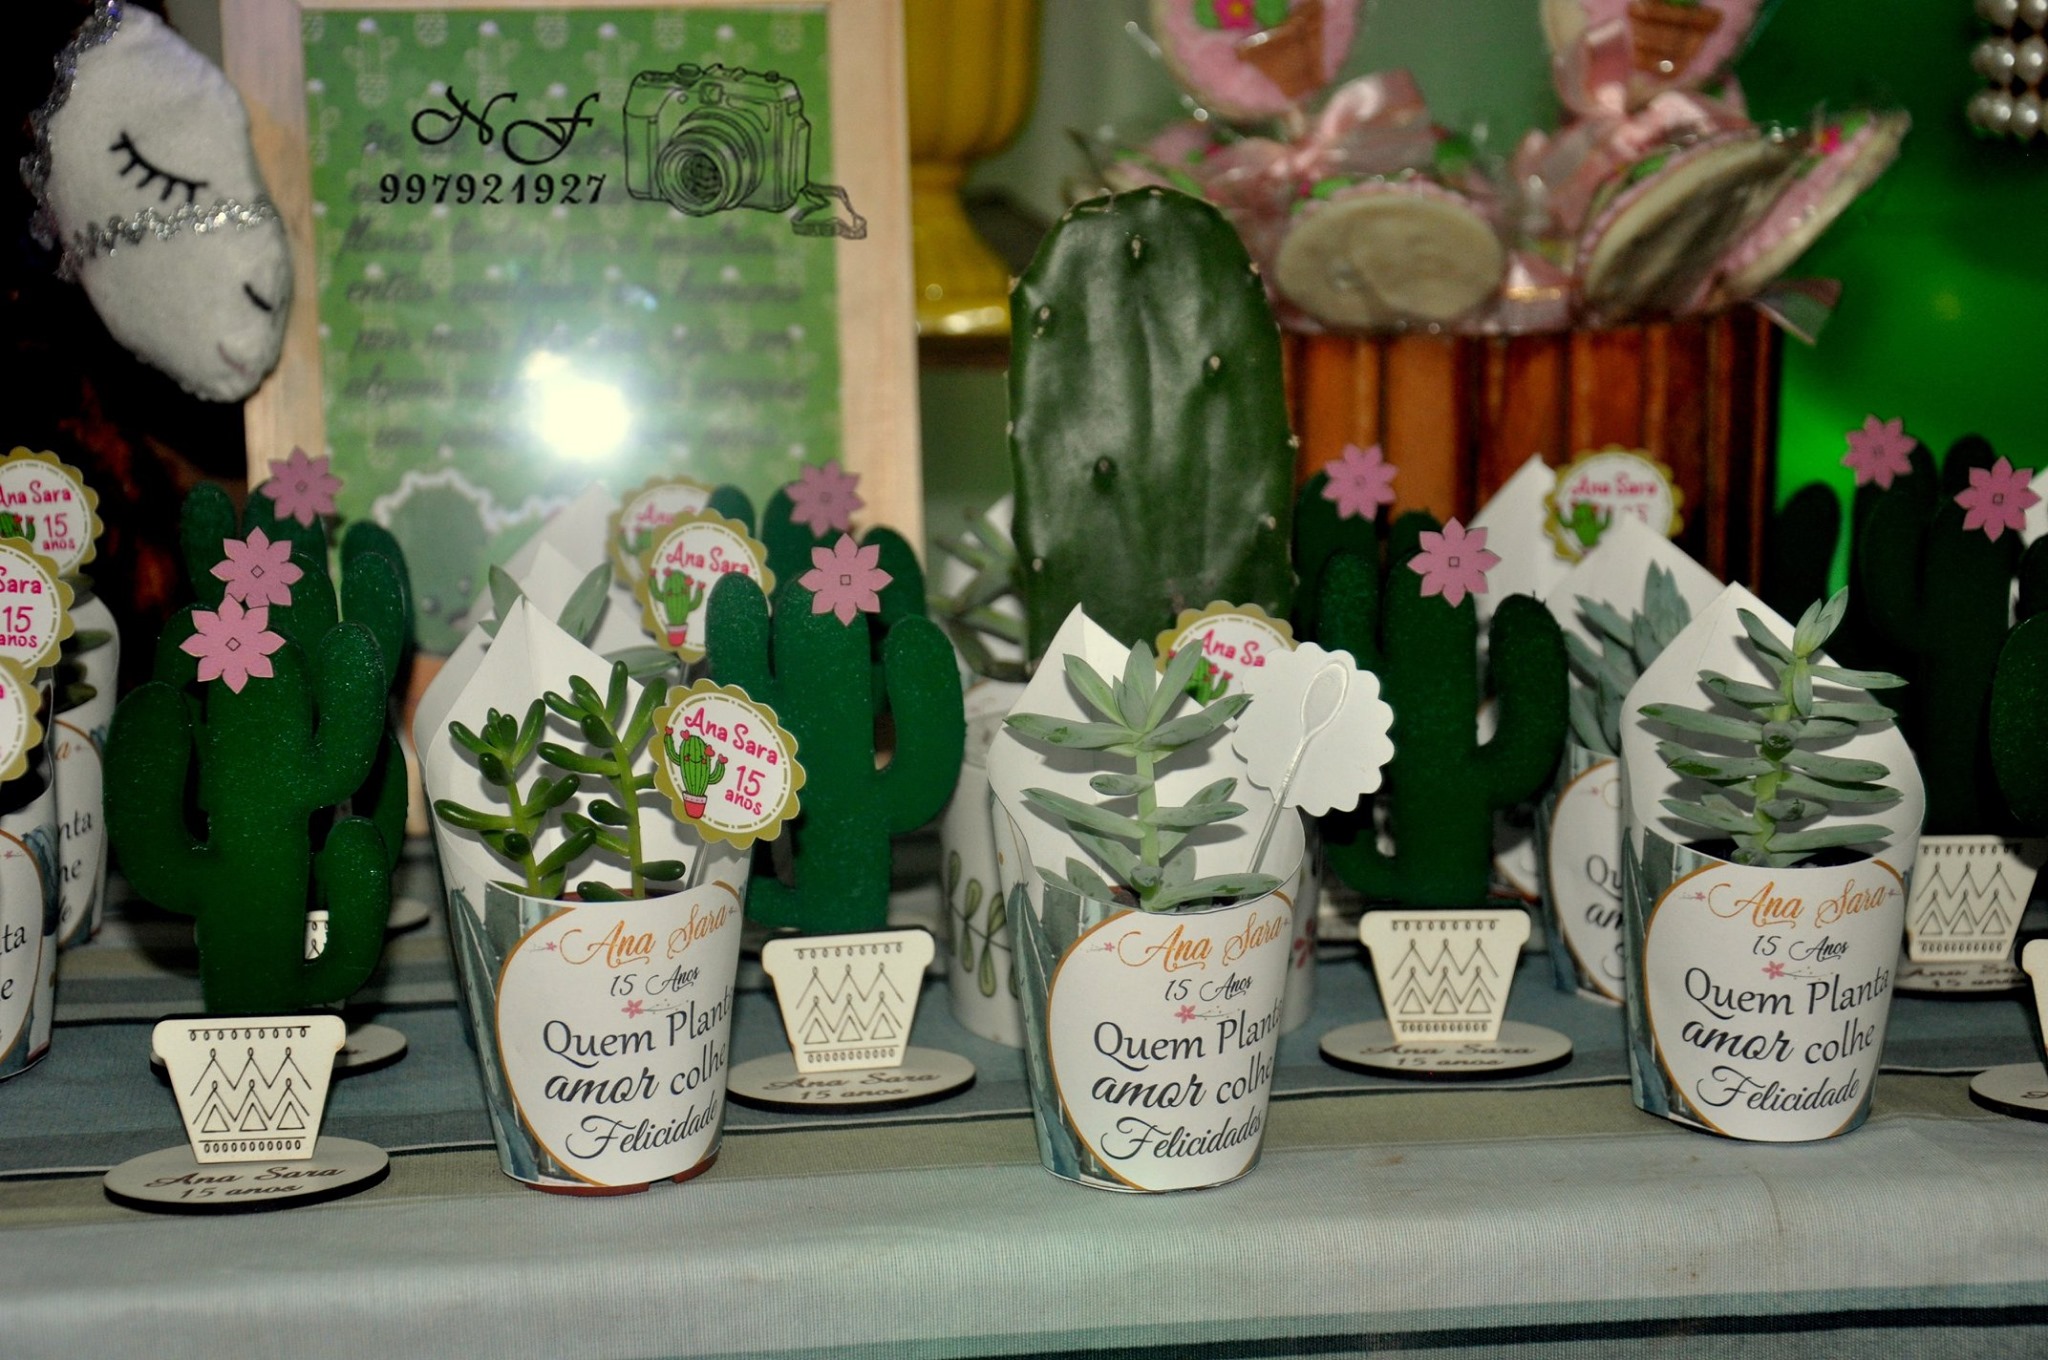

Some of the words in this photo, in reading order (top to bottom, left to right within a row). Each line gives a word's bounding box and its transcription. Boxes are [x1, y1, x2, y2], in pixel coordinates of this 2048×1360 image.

[29, 480, 73, 504] Sara
[43, 512, 68, 538] 15
[42, 537, 76, 551] anos
[666, 541, 705, 569] Ana
[2, 605, 34, 633] 15
[1196, 629, 1237, 660] Ana
[684, 707, 728, 742] Ana
[732, 723, 778, 765] Sara
[736, 765, 766, 797] 15
[724, 788, 763, 816] anos
[1707, 881, 1805, 928] Ana
[1814, 878, 1888, 928] Sara
[558, 919, 656, 969] Ana
[666, 903, 728, 960] Sara
[1117, 923, 1213, 973] Ana
[1221, 912, 1282, 966] Sara
[1752, 935, 1782, 957] 15
[1788, 935, 1849, 962] Anos
[609, 973, 638, 997] 15
[645, 964, 700, 996] Anos
[1164, 978, 1193, 1001] 15
[1199, 971, 1253, 1002] Anos
[1684, 967, 1795, 1021] Quem
[1807, 966, 1889, 1015] Planta
[543, 1019, 657, 1069] Quem
[1093, 1021, 1206, 1072] Quem
[1359, 1043, 1445, 1056] Ana
[1461, 1042, 1537, 1055] Sara
[1681, 1019, 1794, 1063] amor
[1804, 1017, 1875, 1065] colhe
[543, 1066, 661, 1105] amor
[670, 1038, 727, 1096] colhe
[762, 1076, 850, 1091] Ana
[859, 1072, 942, 1086] Sara
[1091, 1073, 1208, 1110] amor
[1216, 1051, 1273, 1105] colhe
[799, 1089, 832, 1100] 15
[840, 1088, 909, 1099] anos
[1696, 1065, 1860, 1112] Felicidade
[143, 1172, 244, 1188] Ana
[253, 1166, 346, 1181] Sara
[179, 1185, 215, 1200] 15
[224, 1184, 305, 1197] anos
